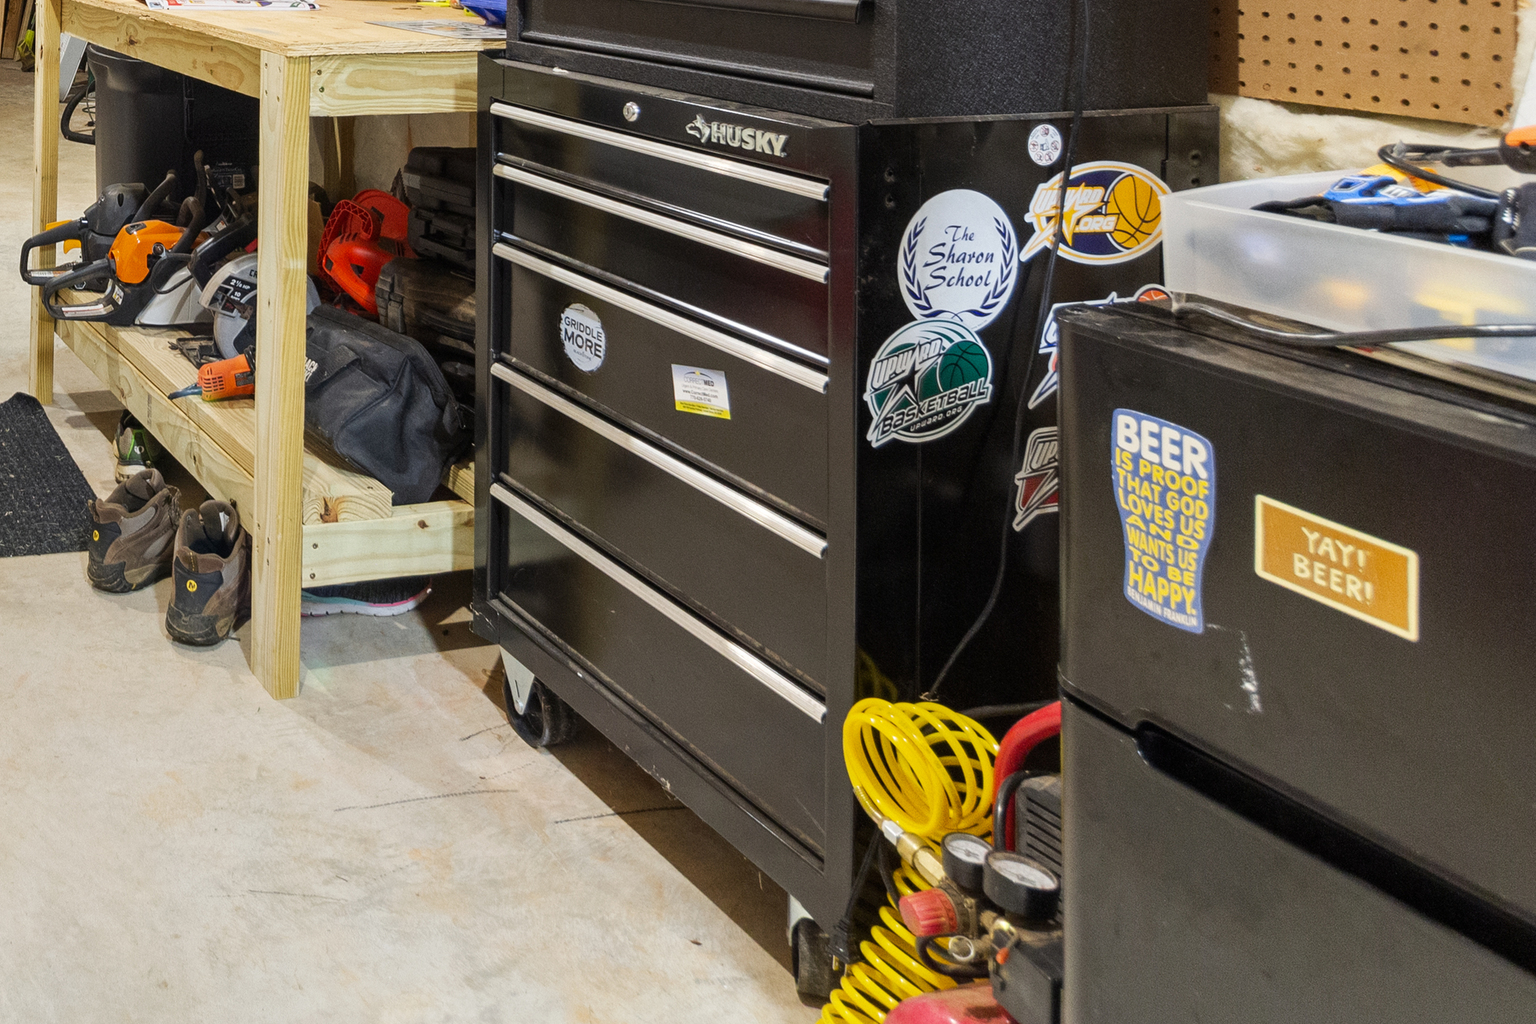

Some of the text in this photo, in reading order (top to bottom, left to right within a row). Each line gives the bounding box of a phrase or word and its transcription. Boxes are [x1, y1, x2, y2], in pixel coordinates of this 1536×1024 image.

[710, 121, 789, 157] HUSKY
[922, 242, 995, 268] Sharon
[944, 225, 976, 243] The
[923, 265, 992, 292] School
[564, 315, 603, 343] GRIDDLE
[564, 328, 603, 360] MORE
[871, 337, 943, 390] UPWARD
[1117, 414, 1208, 480] BEER
[1115, 447, 1209, 499] IS PROOF
[1116, 467, 1209, 520] THAT GOD
[1118, 487, 1206, 540] LOVES US
[1125, 514, 1200, 550] AND
[1125, 523, 1198, 572] WANTS US
[1128, 545, 1195, 587] TO BE
[1301, 526, 1367, 573] YAY!
[1128, 560, 1197, 615] HAPPY.
[1292, 552, 1374, 606] BEER!
[1127, 585, 1198, 627] BENJAMIN FRANKLIN
